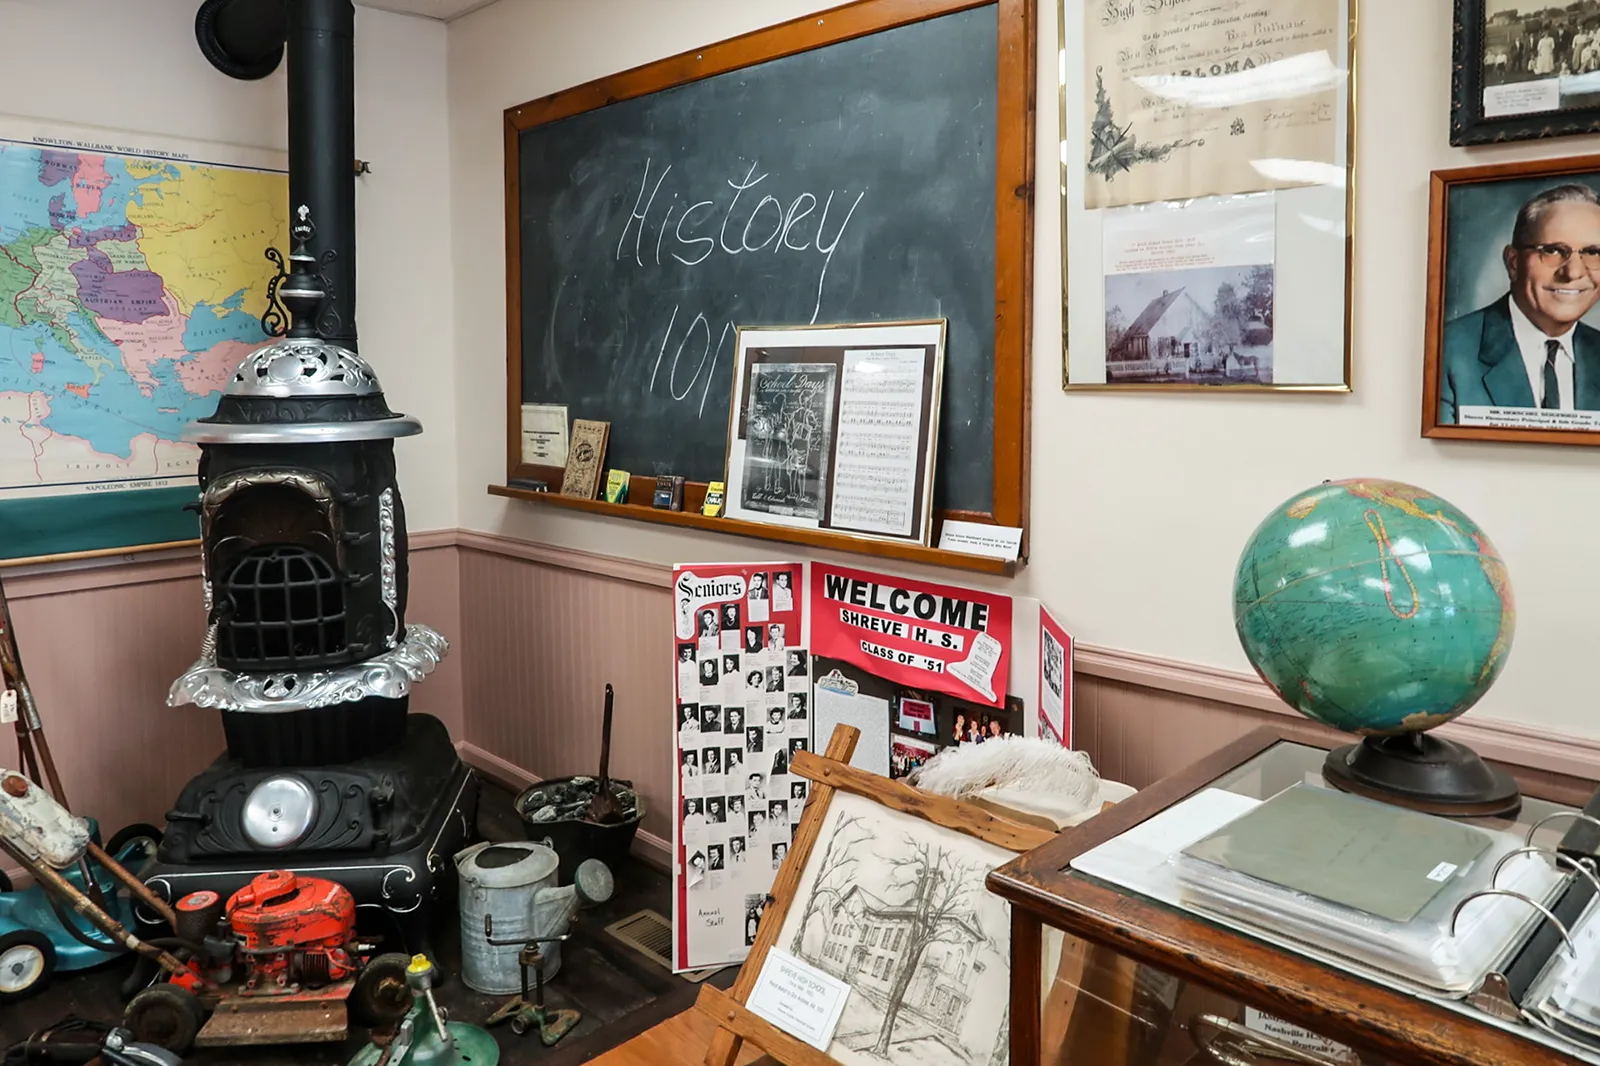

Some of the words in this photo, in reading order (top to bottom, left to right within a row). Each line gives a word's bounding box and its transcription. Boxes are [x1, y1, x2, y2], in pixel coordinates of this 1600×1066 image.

[143, 149, 169, 157] HISTORY
[617, 157, 864, 325] History
[85, 483, 126, 491] NAPOLEONIC
[130, 481, 152, 489] EMPIRE
[678, 577, 741, 598] Seniors
[825, 574, 988, 632] WELCOME
[842, 610, 903, 637] SHREVE
[915, 628, 932, 643] H.
[940, 634, 958, 649] S.
[862, 641, 893, 660] CLASS
[898, 651, 915, 665] OF
[923, 659, 943, 673] '51
[706, 917, 724, 927] Staff
[1265, 1023, 1304, 1038] Nashville
